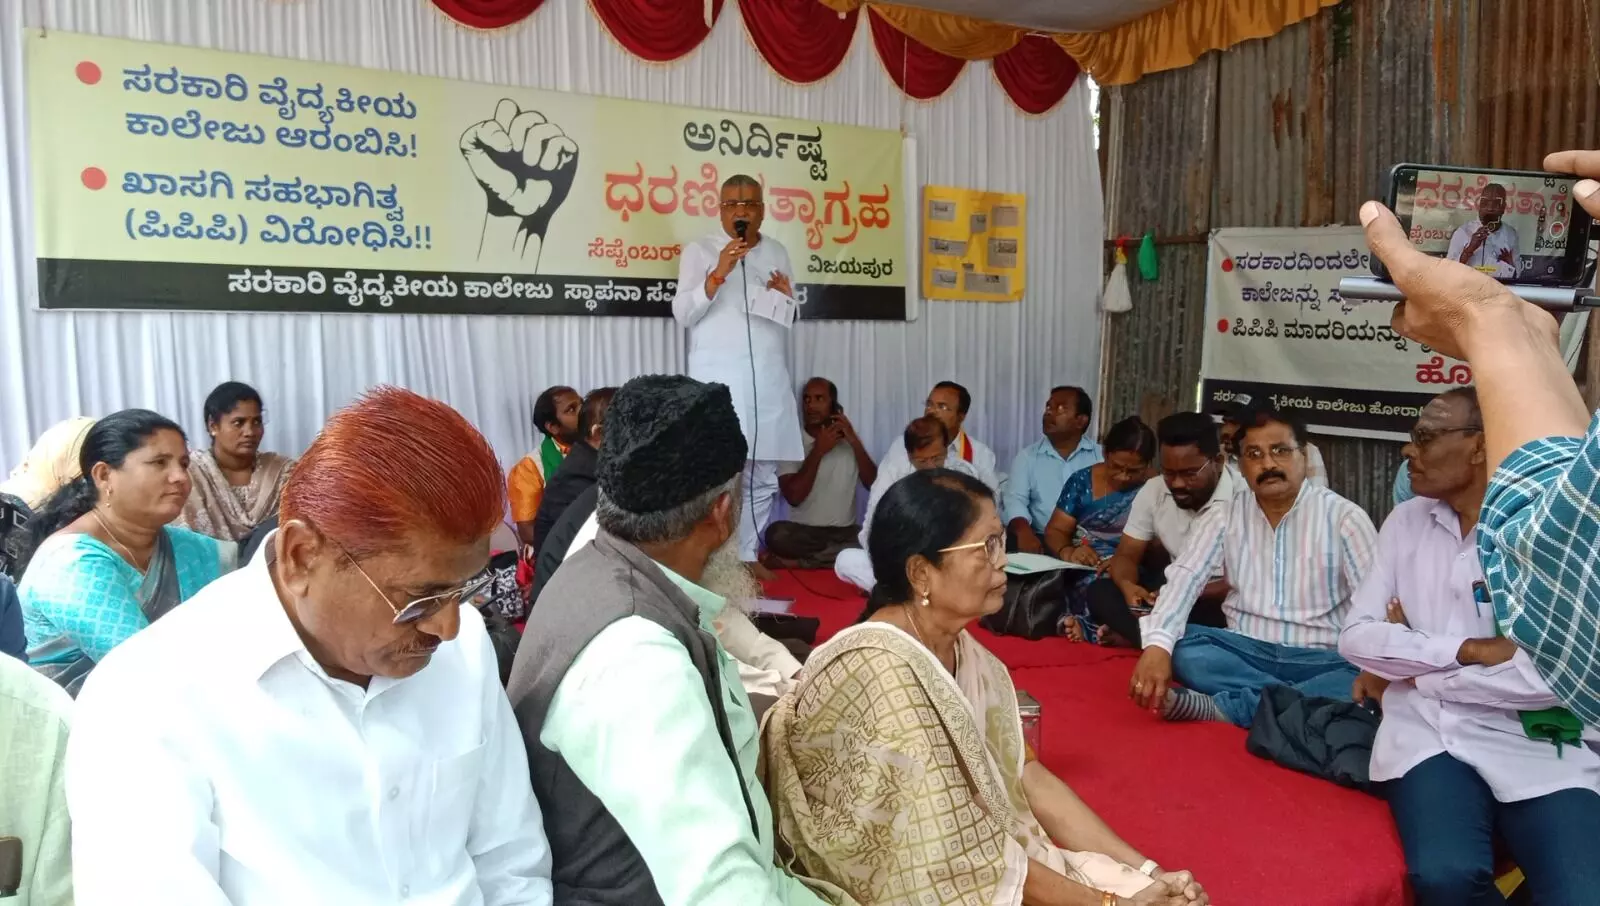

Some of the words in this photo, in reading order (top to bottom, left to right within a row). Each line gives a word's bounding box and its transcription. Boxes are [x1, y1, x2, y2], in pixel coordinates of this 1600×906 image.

[122, 63, 249, 102] ಸರಕಾರಿ
[258, 76, 418, 126] ವೈದ್ಯಕೀಯ
[125, 109, 266, 146] ಕಾಲೇಜು
[683, 118, 828, 182] ಅನಿರ್ದಿಷ್ಟ
[121, 169, 234, 201] ಖಾಸಗಿ
[244, 173, 405, 223] ಸಹಭಾಗಿತ್ವ
[759, 172, 892, 251] ತ್ಯಾಗ್ರಹ
[124, 207, 248, 245] (ಪಿಪಿಪಿ)
[259, 213, 432, 252] ವಿರೋಧಿಸಿ!!
[587, 236, 682, 269] ಸೆಪ್ಟೆಂಬರ್
[807, 253, 894, 279] ವಿಜಯಪುರ
[1235, 248, 1369, 272] ಸರಕಾರದಿಂದಲೇ
[227, 267, 327, 295] ಸರಕಾರಿ
[332, 270, 459, 308] ವೈದ್ಯಕೀಯ
[463, 274, 554, 300] ಕಾಲೇಜು
[563, 279, 643, 312] ಸ್ಥಾಪನಾ
[1241, 281, 1321, 312] ಕಾಲೇಜನ್ನು
[1232, 317, 1279, 338] ಪಿಪಿಪಿ
[1316, 398, 1367, 414] ಕಾಲೇಜು
